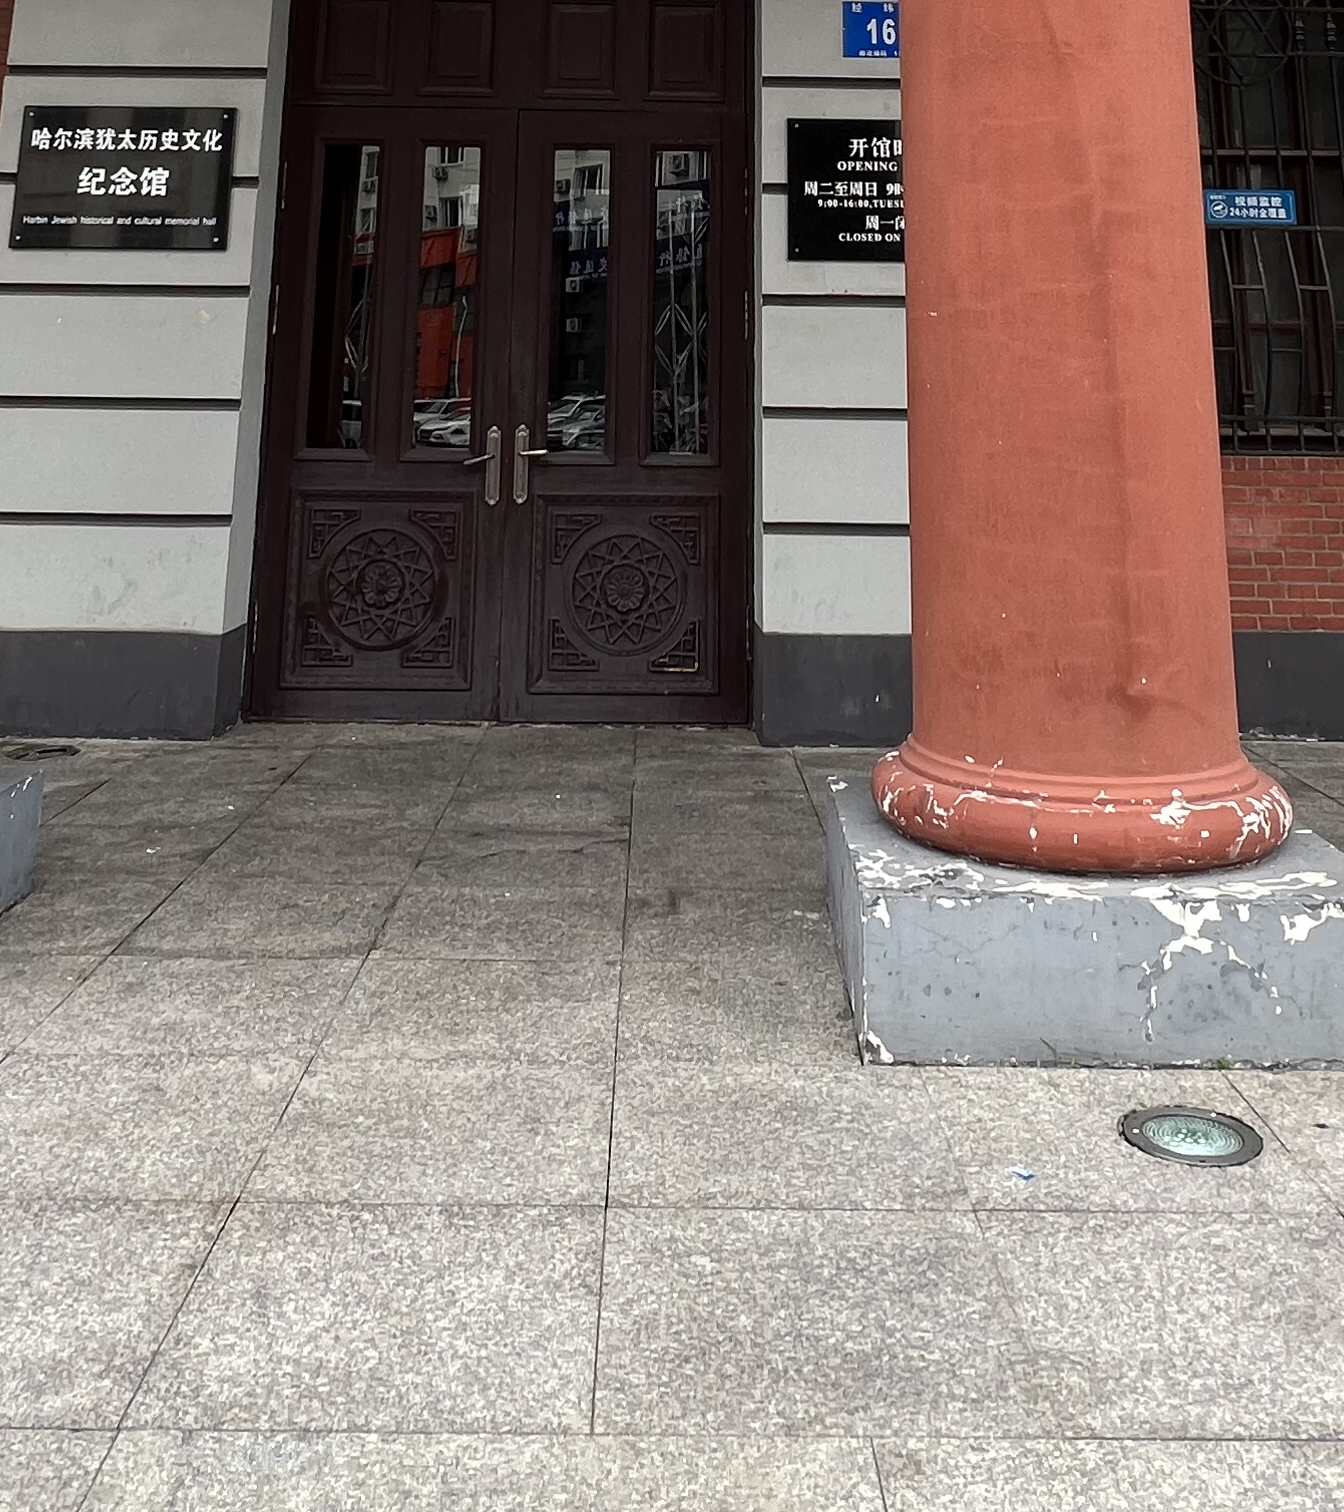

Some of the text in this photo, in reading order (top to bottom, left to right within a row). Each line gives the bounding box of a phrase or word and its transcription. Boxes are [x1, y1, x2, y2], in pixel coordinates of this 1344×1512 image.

[30, 127, 223, 152] 哈尔滨犹太历史文化
[837, 160, 898, 172] OPENING
[76, 166, 170, 197] 纪念馆
[804, 180, 878, 197] 周二至周日
[23, 216, 48, 225] Harbin
[51, 216, 78, 225] Jewish
[80, 216, 115, 225] historical
[117, 216, 132, 225] and
[134, 216, 163, 225] cultural
[165, 216, 200, 225] memorial
[838, 232, 901, 243] CLOSED ON
